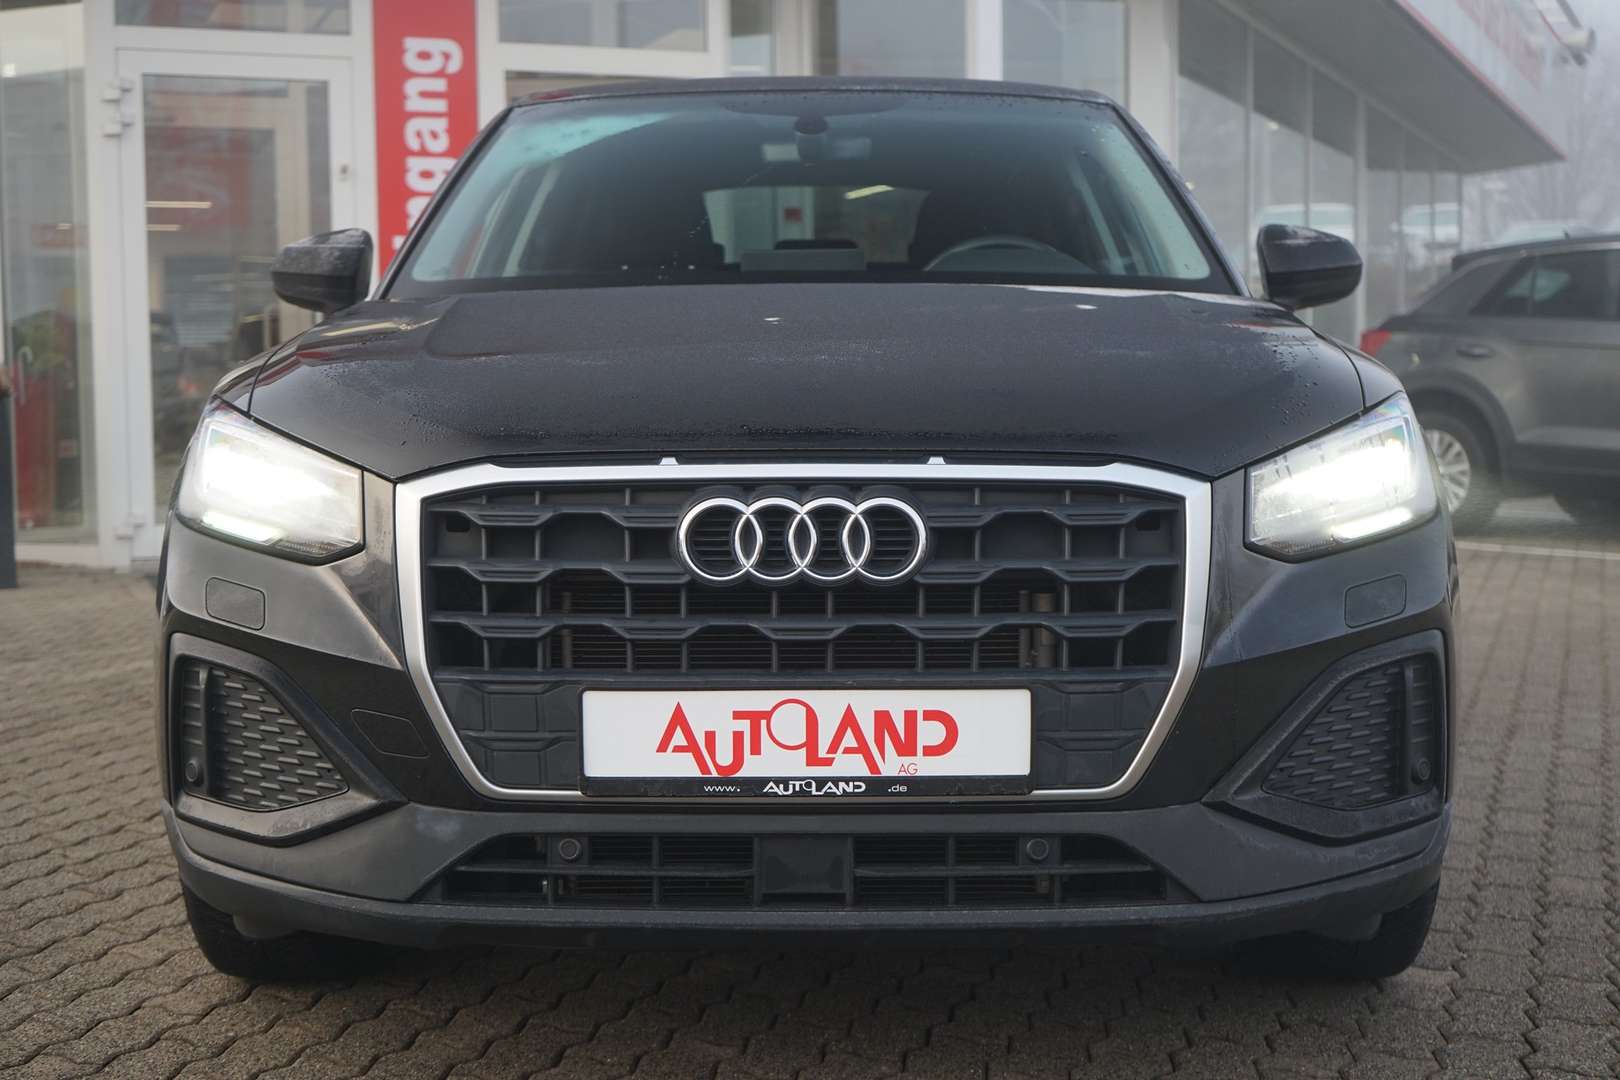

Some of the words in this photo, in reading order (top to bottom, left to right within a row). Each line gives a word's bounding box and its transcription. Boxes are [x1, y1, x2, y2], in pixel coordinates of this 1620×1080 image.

[656, 698, 959, 777] AUTOLAND
[897, 762, 918, 776] AG
[762, 779, 866, 796] AUTOLAND
[888, 784, 908, 792] .de
